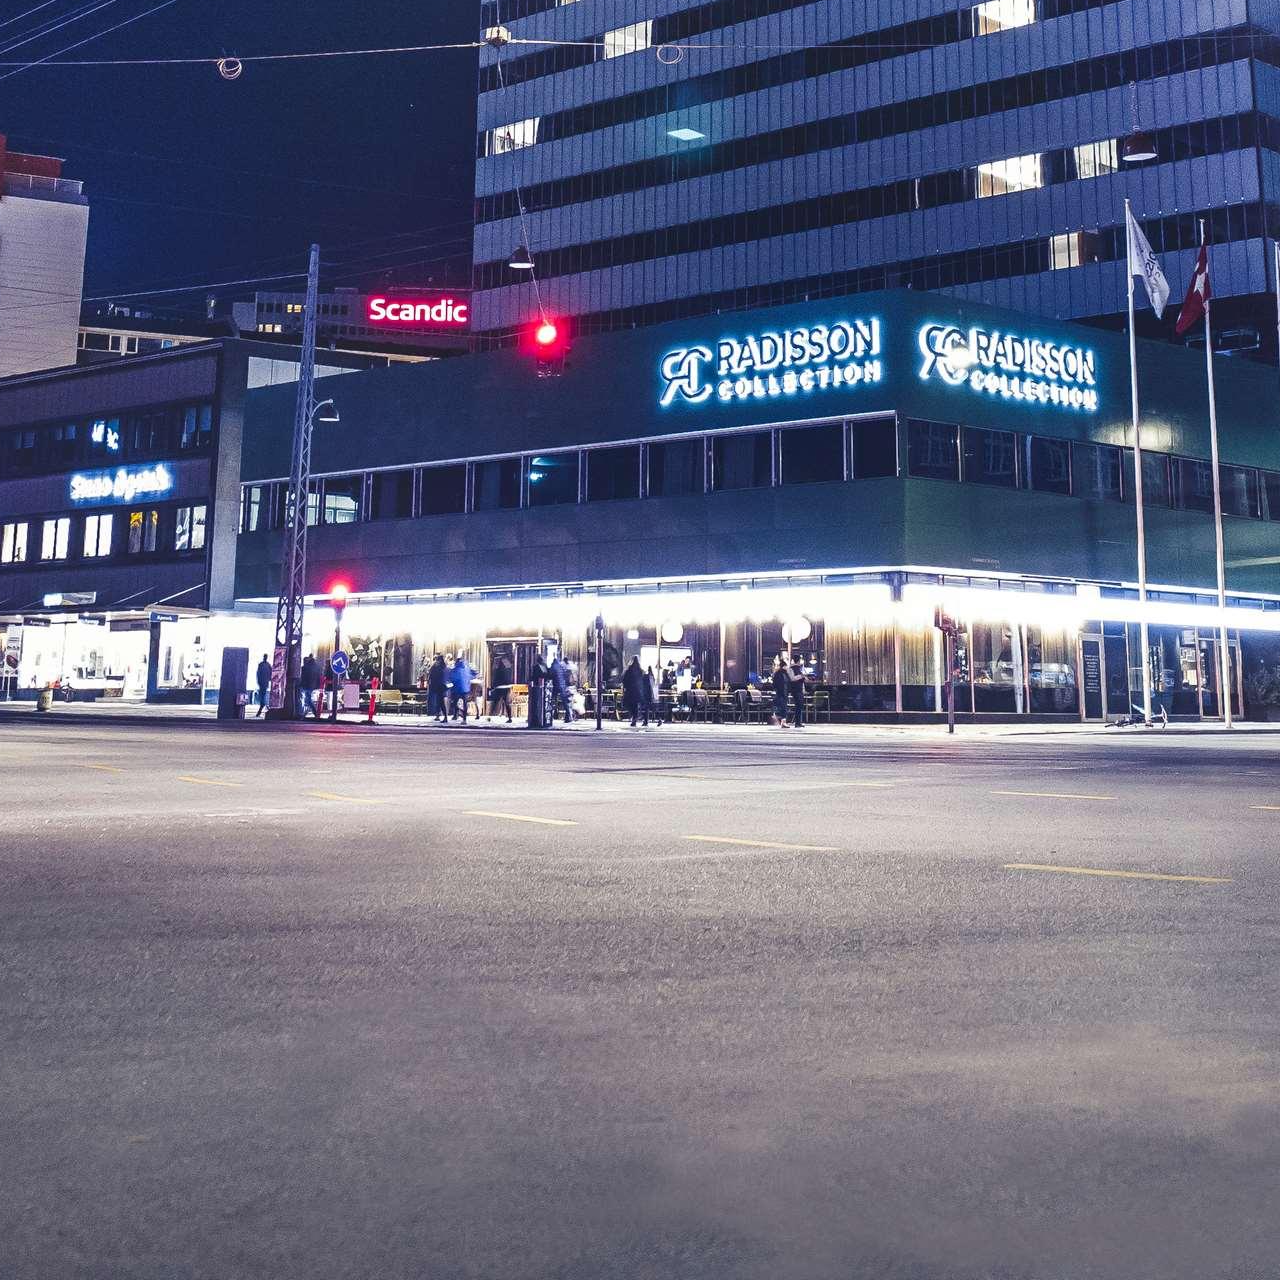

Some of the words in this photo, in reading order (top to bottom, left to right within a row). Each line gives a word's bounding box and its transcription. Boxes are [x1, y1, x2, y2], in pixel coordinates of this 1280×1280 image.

[370, 299, 467, 322] Scandic
[717, 317, 881, 376] RADISSON
[970, 328, 1096, 386] RADISSON
[718, 361, 881, 400] COLLECTION
[970, 370, 1098, 410] COLLECTION
